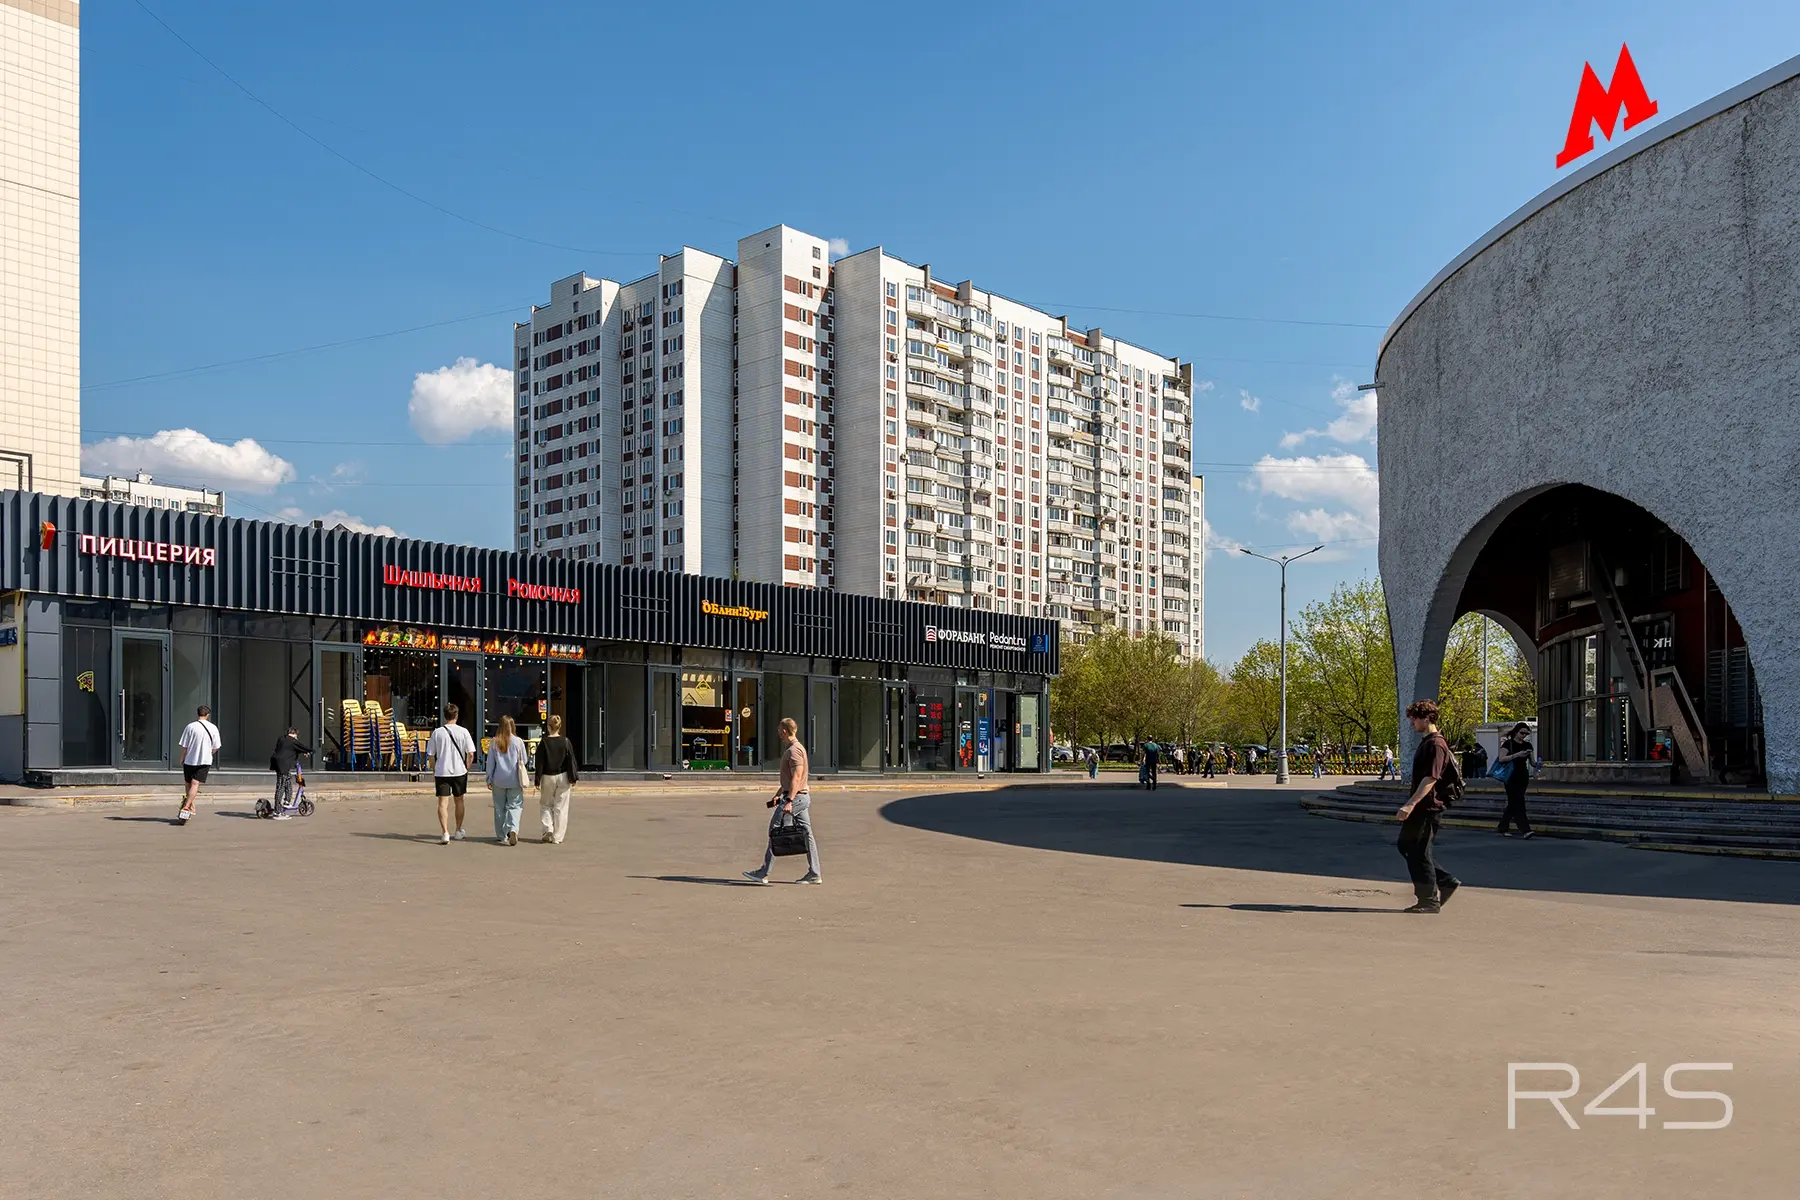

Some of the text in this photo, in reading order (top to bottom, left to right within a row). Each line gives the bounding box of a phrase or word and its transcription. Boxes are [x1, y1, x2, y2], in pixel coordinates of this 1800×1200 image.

[80, 533, 216, 567] ПИЦЦЕРИЯ
[383, 563, 482, 593] ШАШЛЫЧНАЯ
[507, 577, 581, 604] РЮМОЧНАЯ
[938, 628, 986, 645] ФОРАБАНК
